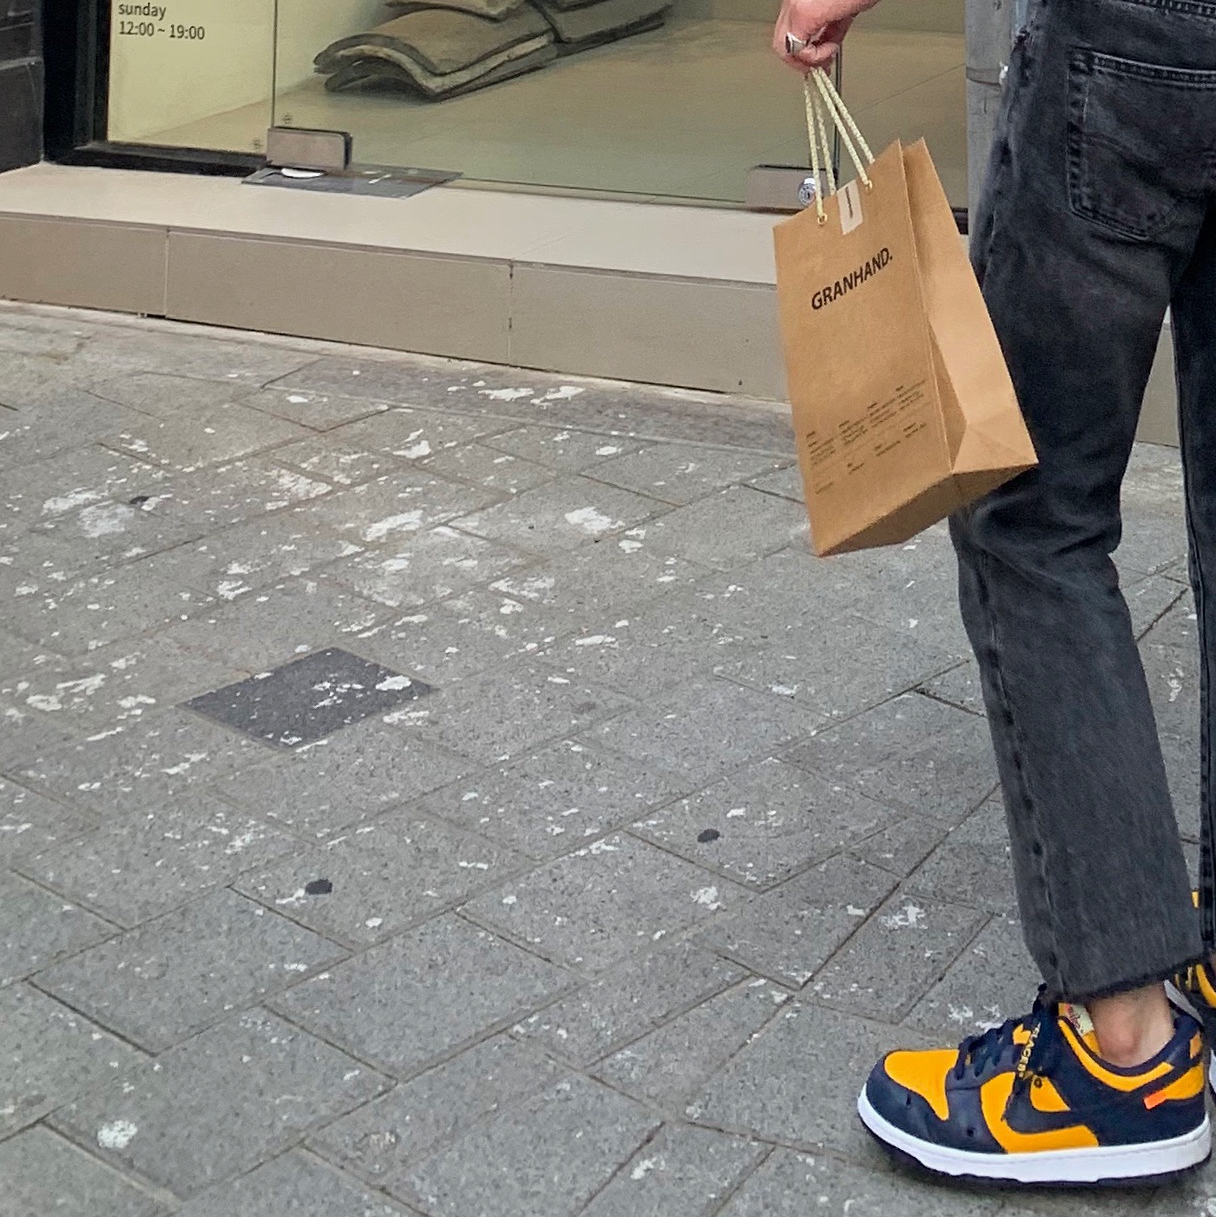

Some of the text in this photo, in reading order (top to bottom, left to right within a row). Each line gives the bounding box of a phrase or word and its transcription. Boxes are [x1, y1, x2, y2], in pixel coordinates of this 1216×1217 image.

[118, 2, 167, 21] sunday
[119, 20, 155, 37] 12:00
[169, 24, 205, 40] 19:00
[811, 247, 894, 310] GRANHAND.
